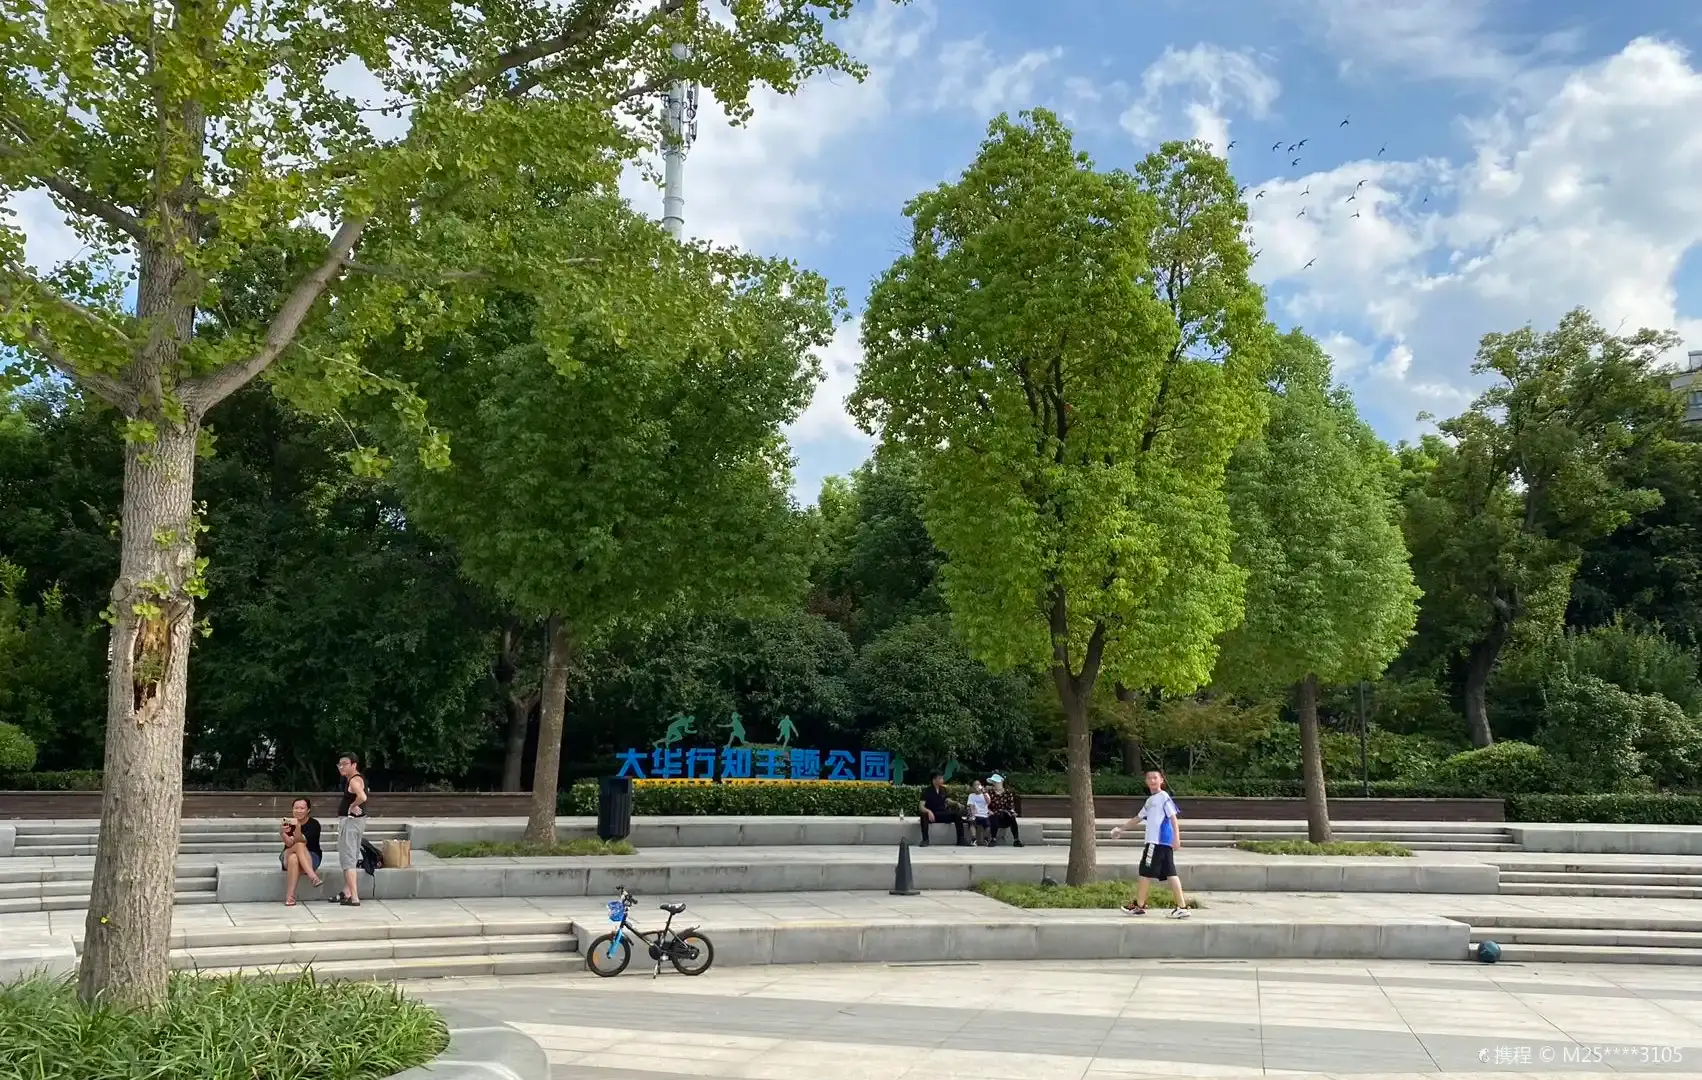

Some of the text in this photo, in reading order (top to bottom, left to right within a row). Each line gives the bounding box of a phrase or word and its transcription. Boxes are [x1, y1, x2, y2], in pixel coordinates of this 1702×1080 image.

[615, 747, 890, 781] 大华行知主题公园
